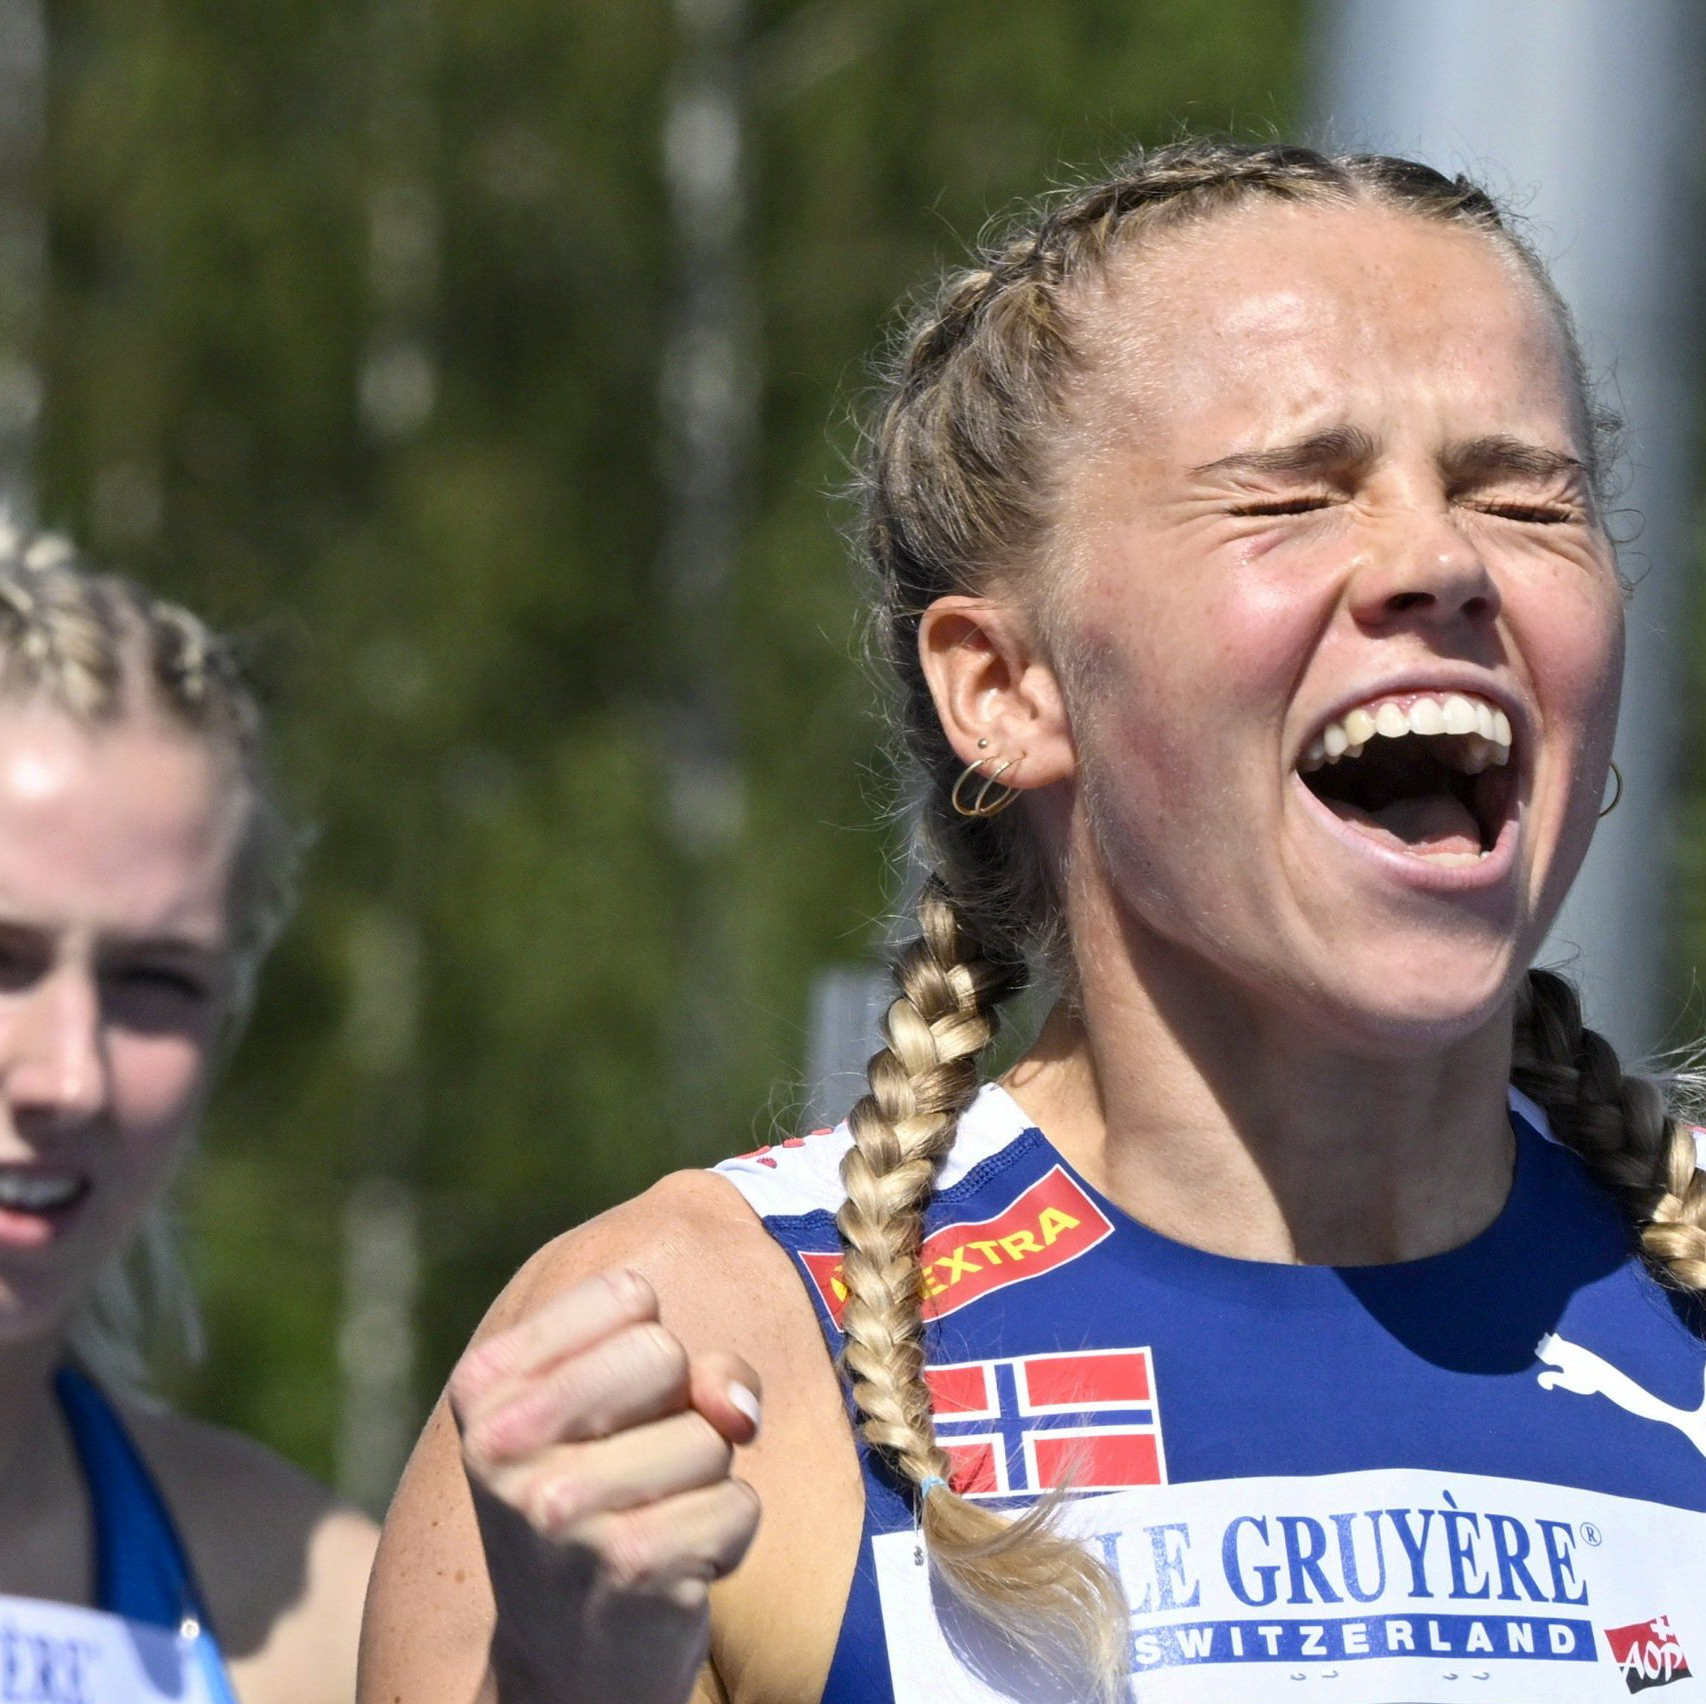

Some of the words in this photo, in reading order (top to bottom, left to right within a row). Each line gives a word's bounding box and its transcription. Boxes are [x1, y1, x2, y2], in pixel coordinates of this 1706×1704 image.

[919, 1206, 1081, 1300] EXTRA
[1095, 1522, 1200, 1615] LE
[1135, 1620, 1577, 1666] SWITZERLAND
[1621, 1637, 1687, 1682] AOP
